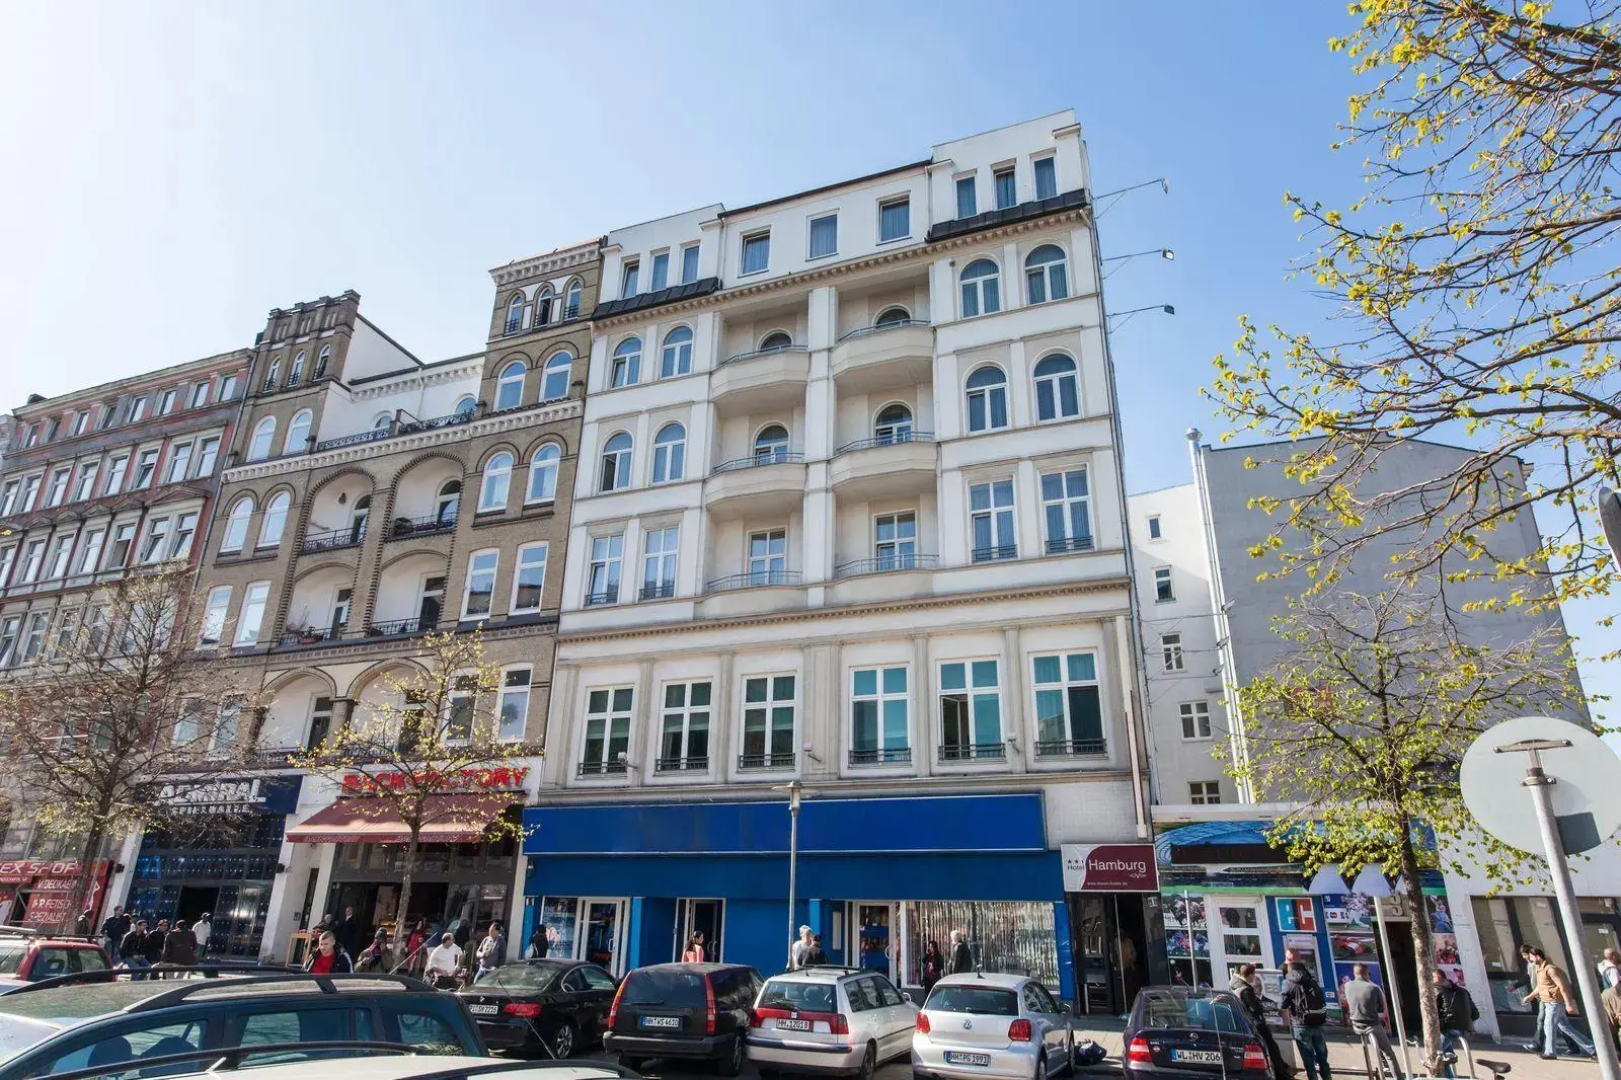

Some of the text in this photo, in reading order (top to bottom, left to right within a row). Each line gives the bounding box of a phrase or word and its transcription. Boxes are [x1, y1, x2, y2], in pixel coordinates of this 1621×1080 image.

[1088, 859, 1147, 873] Hamburg
[972, 1055, 987, 1063] 1991
[1176, 1051, 1220, 1061] WL HV 206
